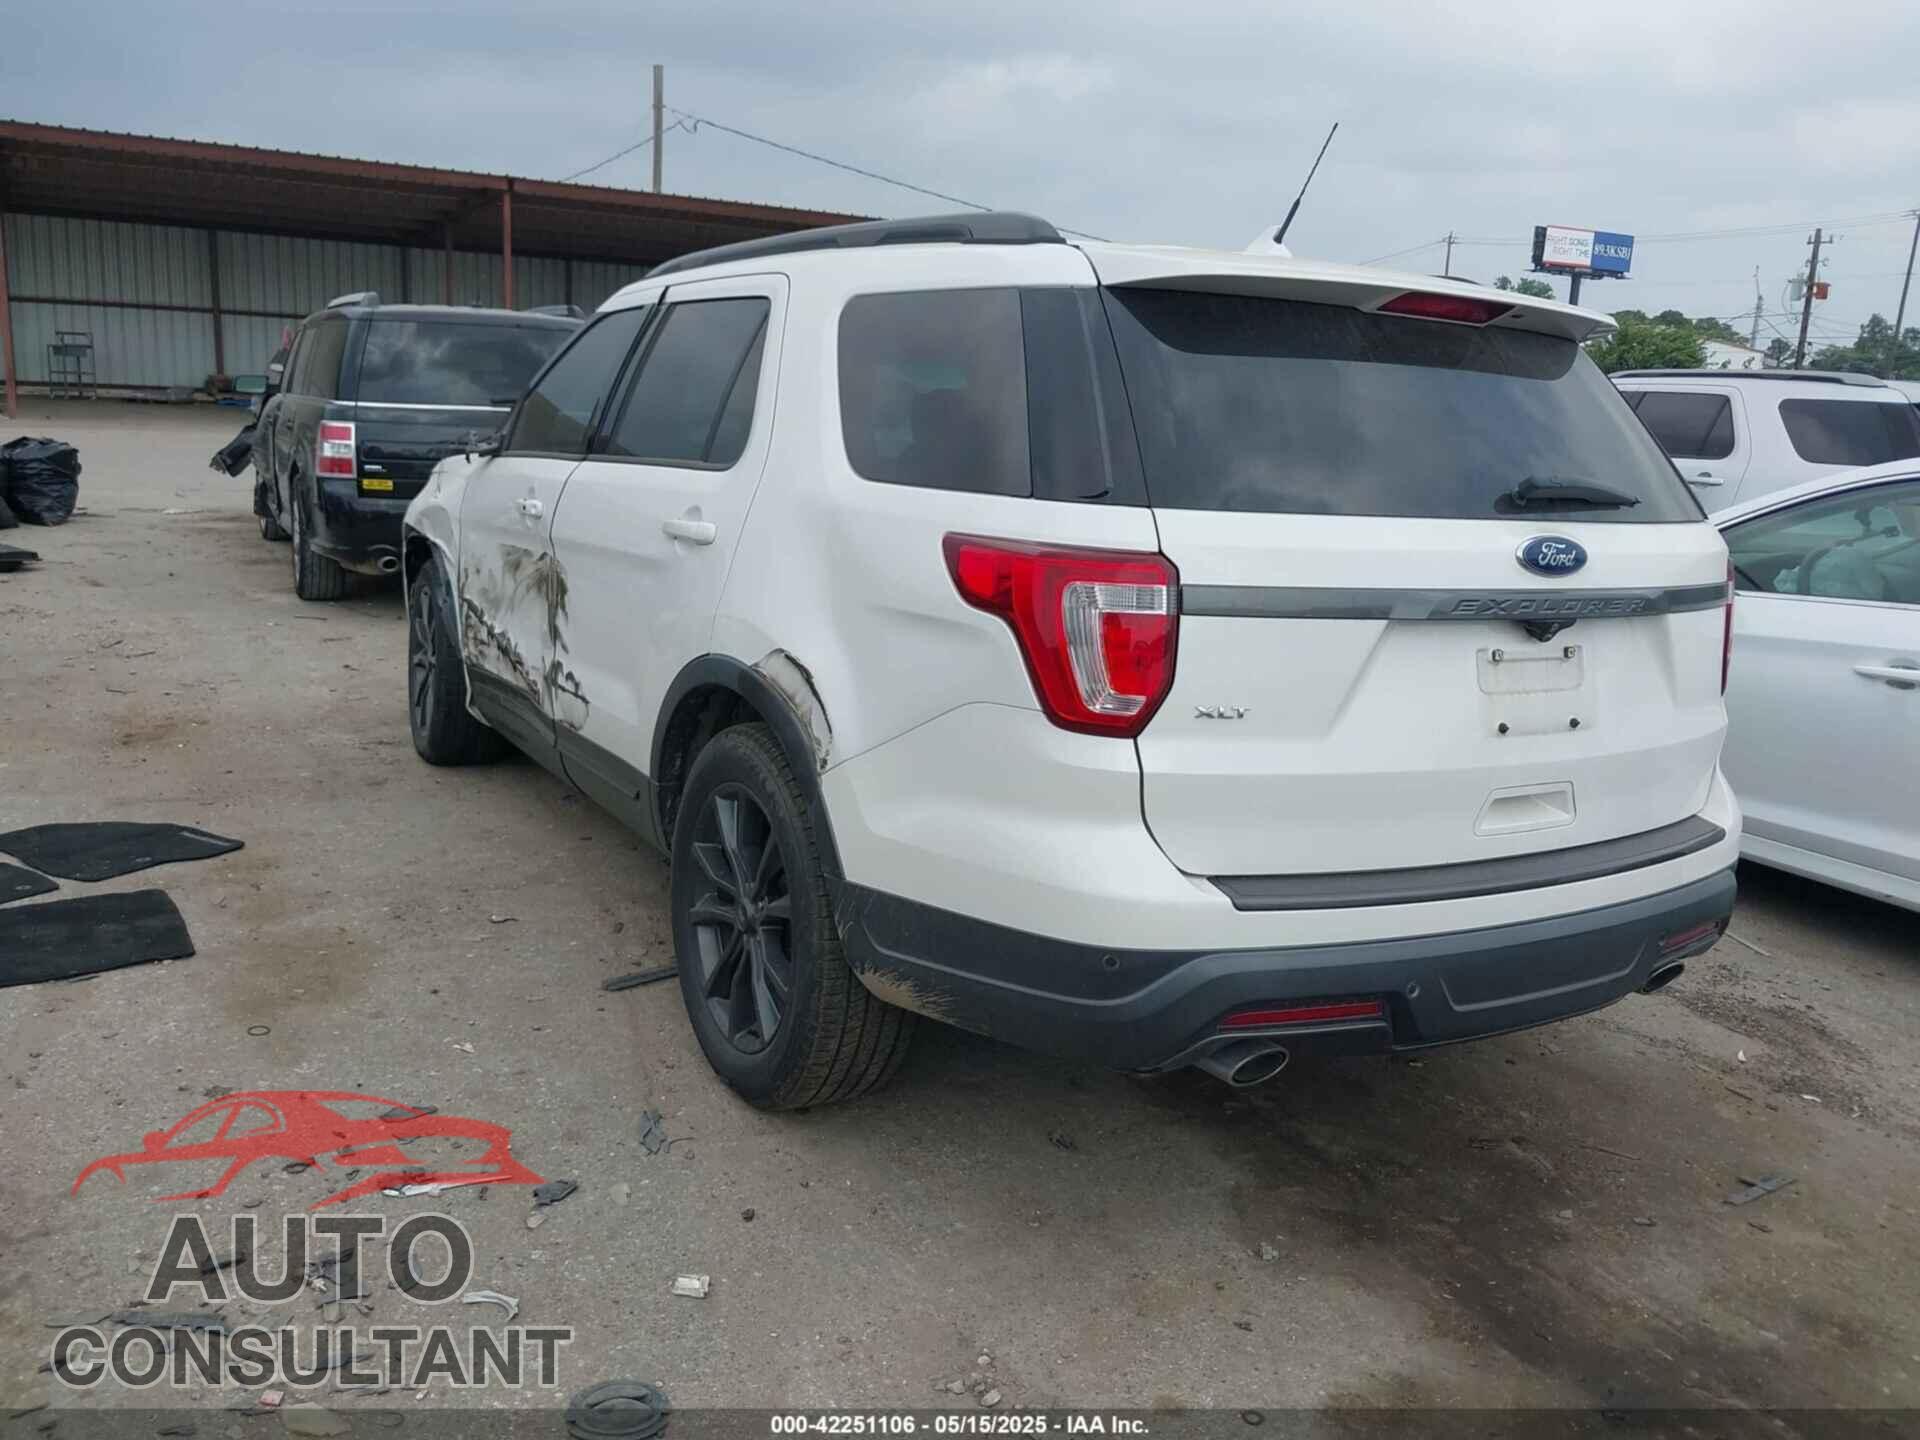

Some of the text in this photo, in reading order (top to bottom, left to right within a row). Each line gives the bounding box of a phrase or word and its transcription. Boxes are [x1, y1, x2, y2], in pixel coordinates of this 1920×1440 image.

[1538, 542, 1577, 566] Ford
[1451, 599, 1647, 615] EXPLORER
[1194, 705, 1252, 719] XLT
